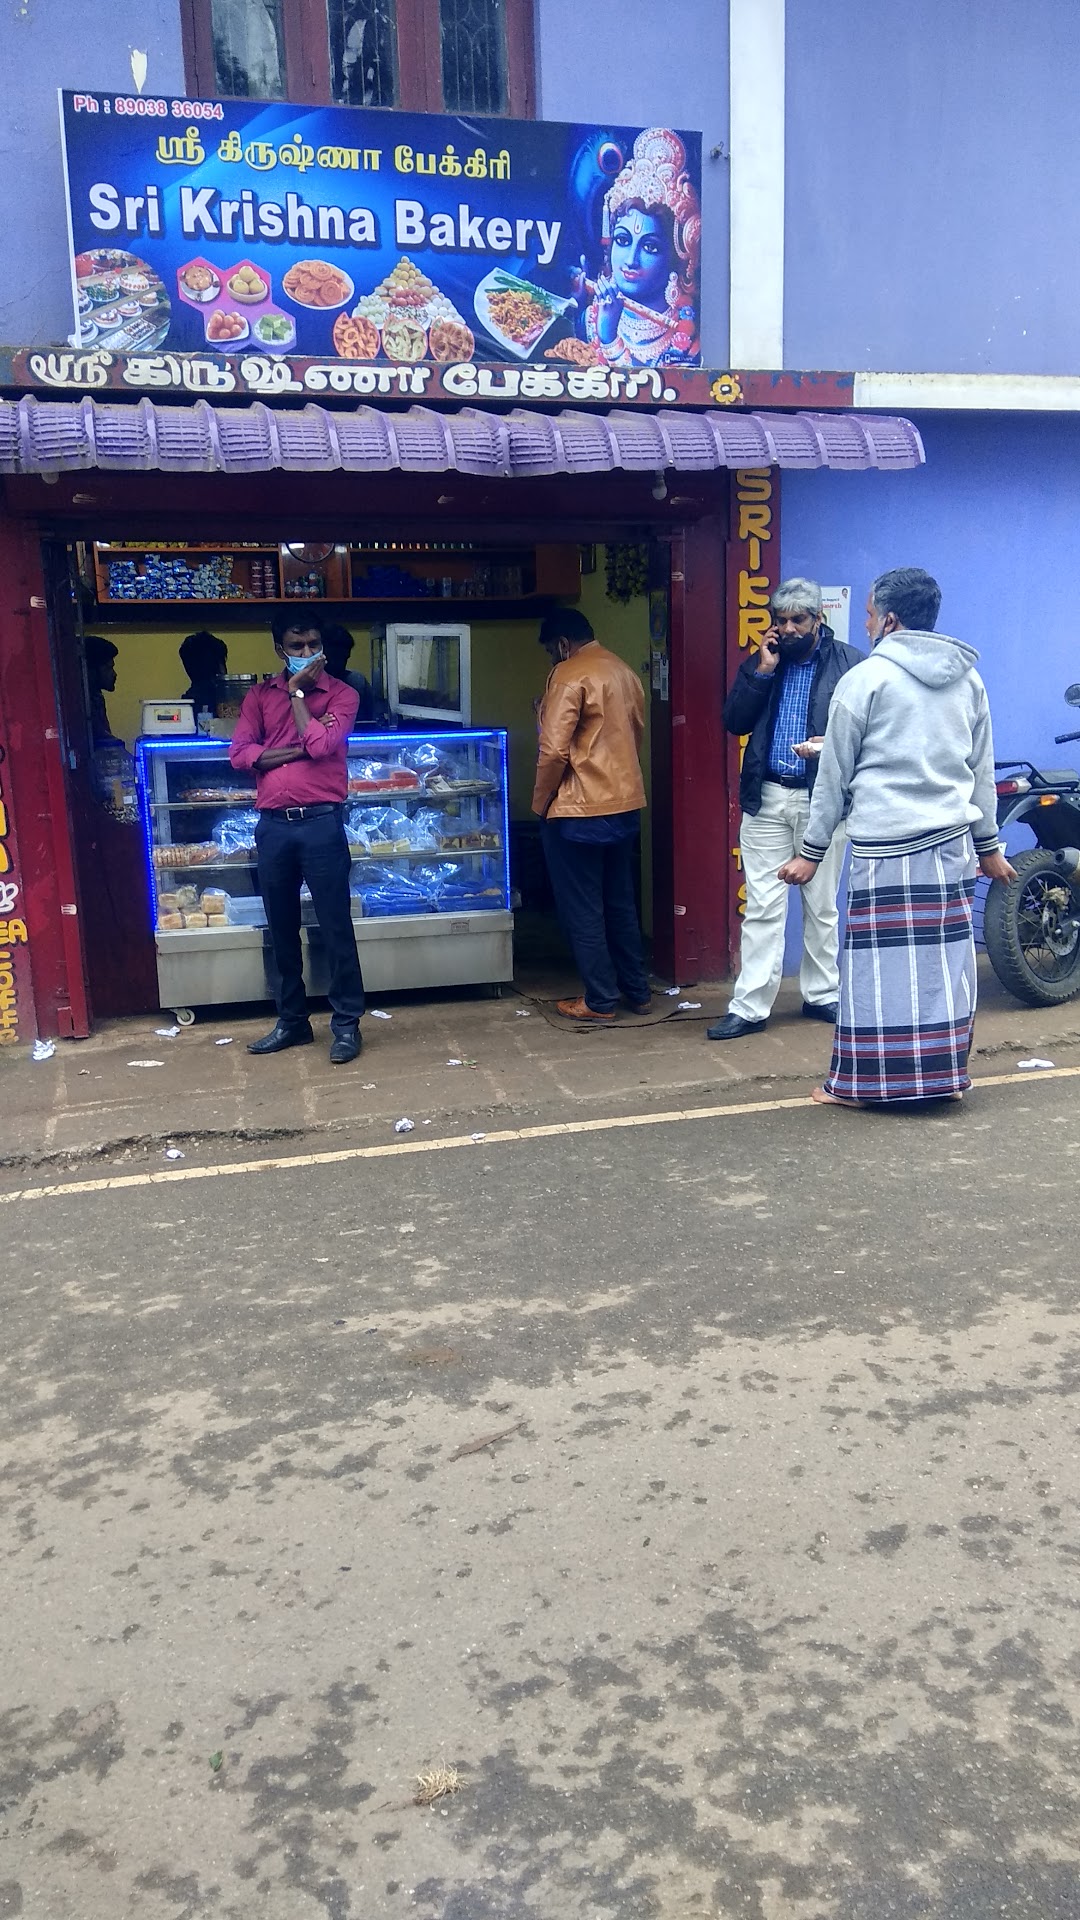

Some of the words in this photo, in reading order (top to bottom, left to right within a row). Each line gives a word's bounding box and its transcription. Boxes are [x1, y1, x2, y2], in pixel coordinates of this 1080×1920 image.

[73, 95, 98, 112] Ph
[115, 97, 168, 116] 89038
[171, 102, 224, 120] 36054
[217, 131, 382, 173] கிருஷ்ணா
[394, 144, 511, 180] பேக்கிரி
[89, 183, 161, 232] Sri
[180, 186, 376, 242] Krishna
[395, 199, 562, 265] Bakery
[122, 354, 431, 393] கிருஷ்ணா
